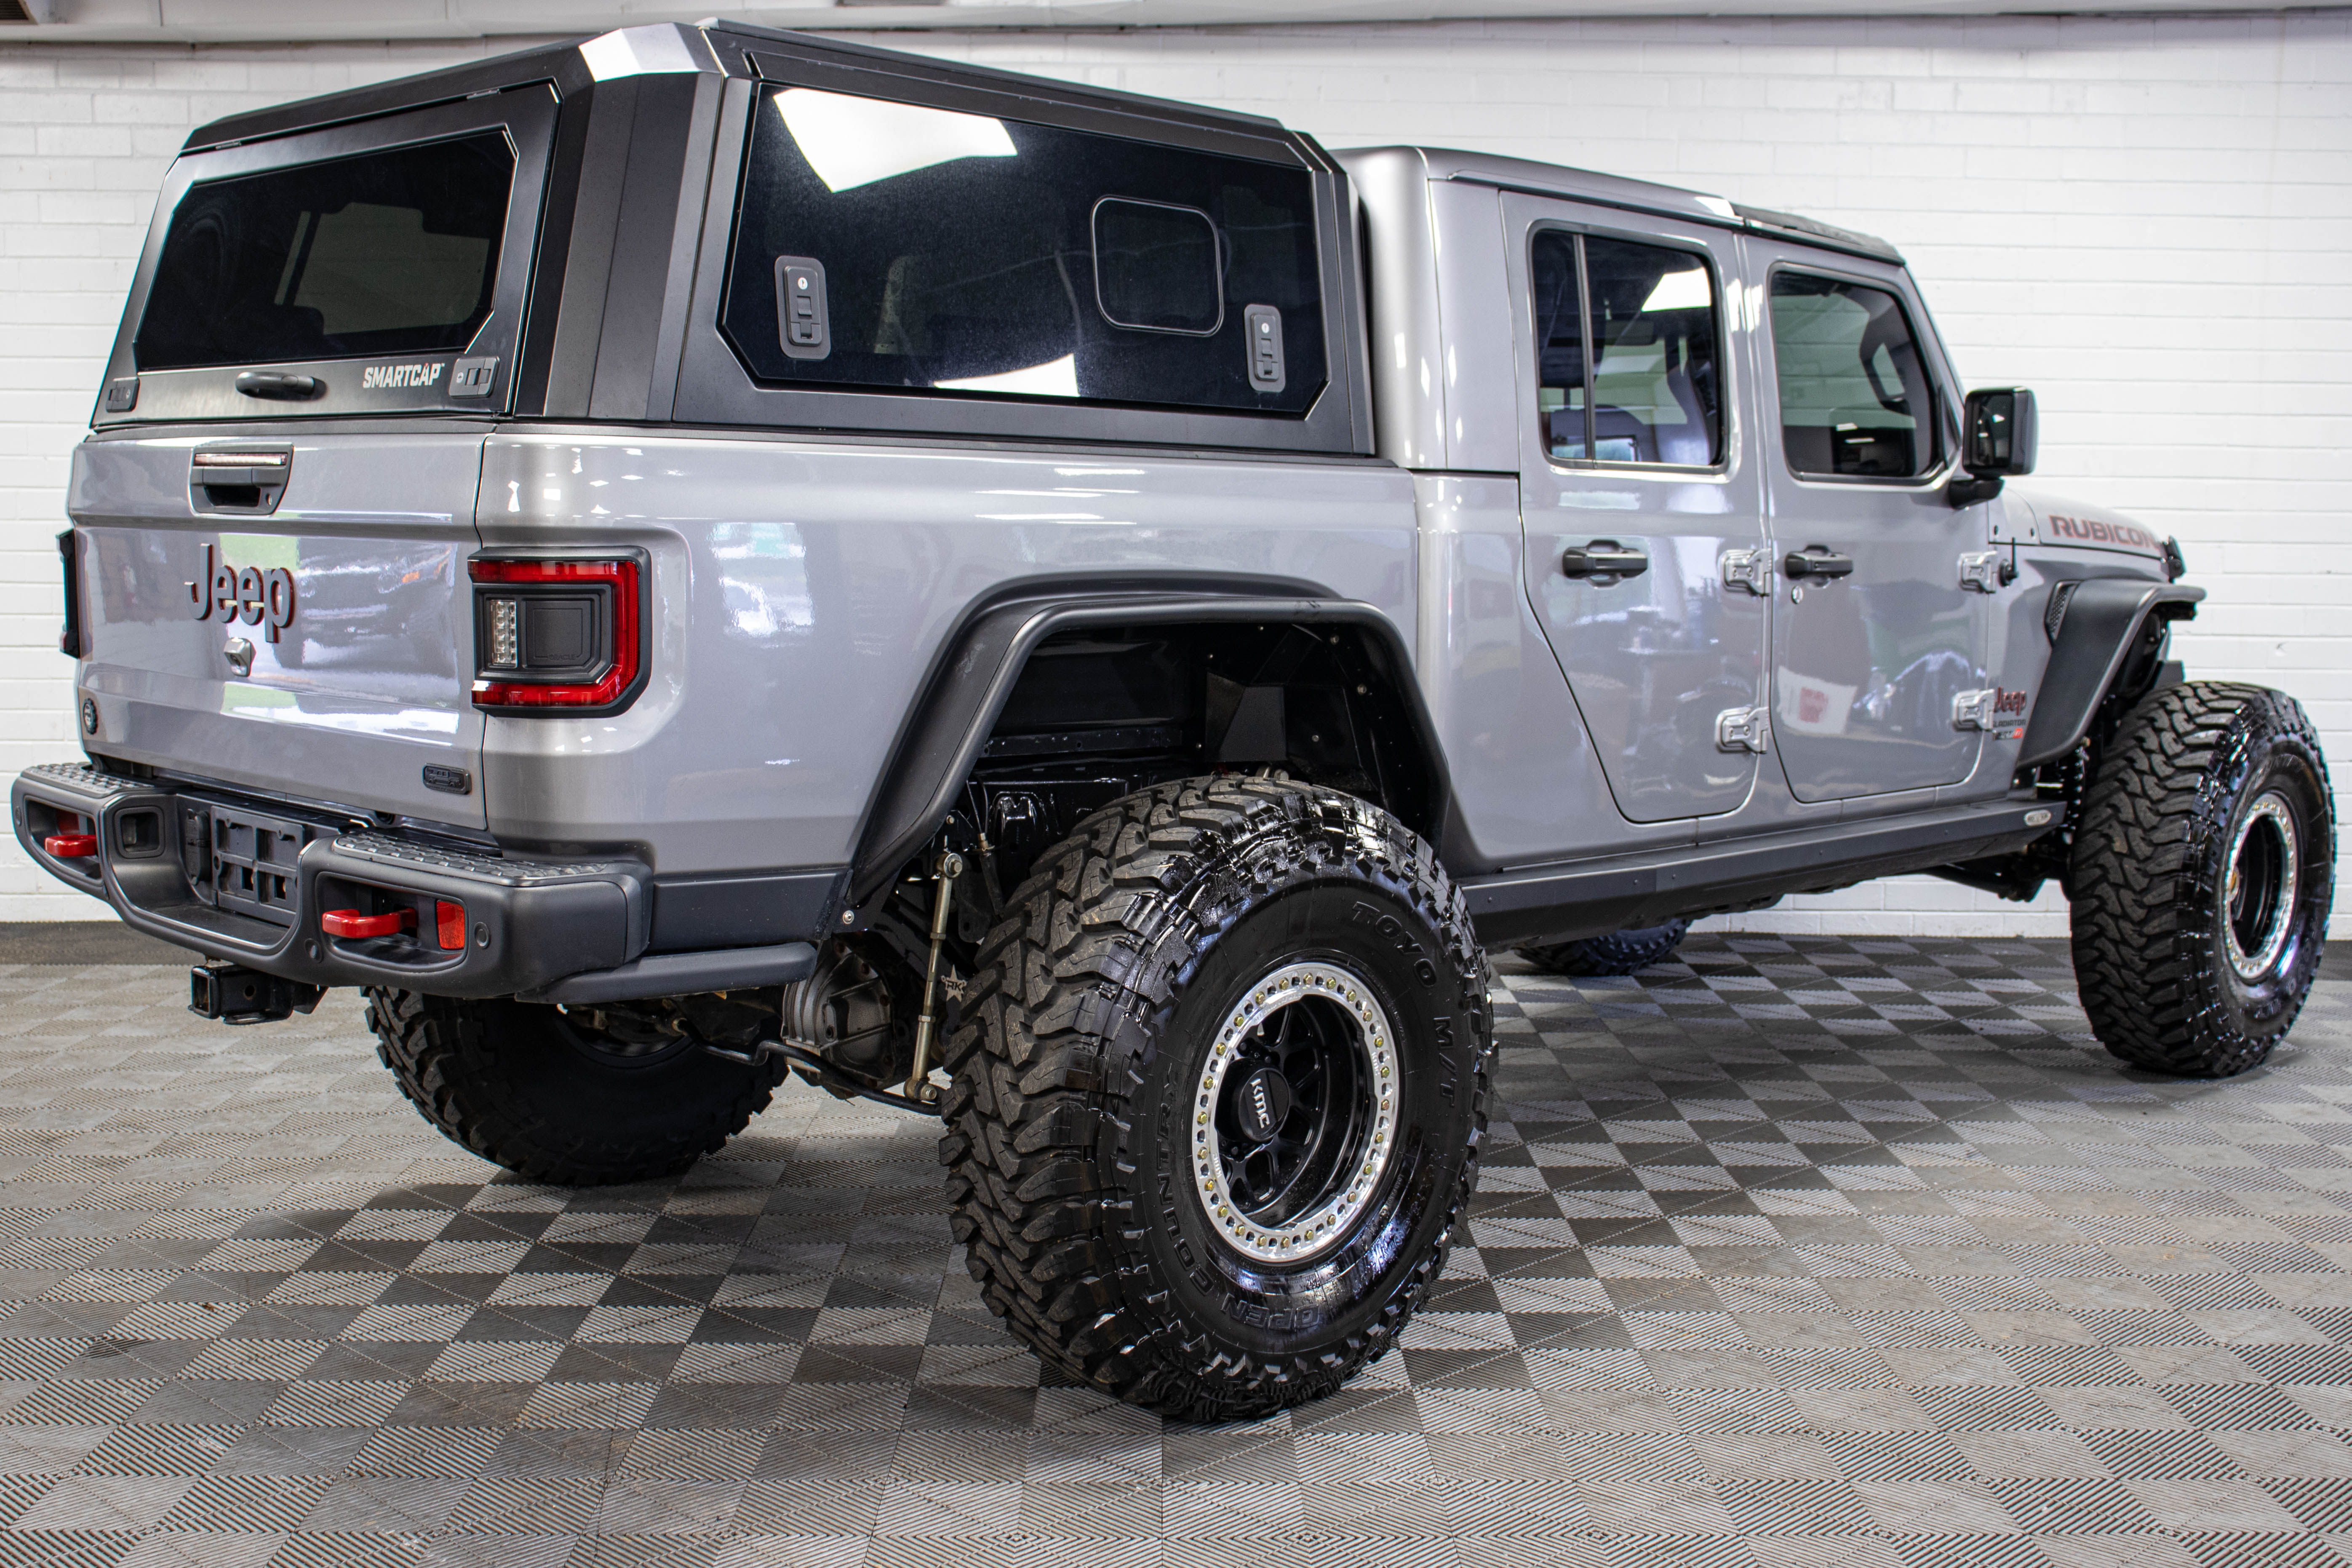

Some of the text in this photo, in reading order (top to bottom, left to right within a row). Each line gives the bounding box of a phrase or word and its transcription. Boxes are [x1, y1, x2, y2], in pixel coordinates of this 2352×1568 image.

[363, 363, 441, 388] SMARTCAP
[2048, 514, 2160, 550] RUBICON
[184, 543, 296, 644] Jeep
[1993, 686, 2027, 716] Jeep
[1352, 900, 1437, 988] TOYO
[947, 980, 962, 992] RK
[1433, 1016, 1457, 1108] M/T
[1156, 1062, 1215, 1296] COUNTRY
[1220, 1292, 1320, 1331] OPEN
